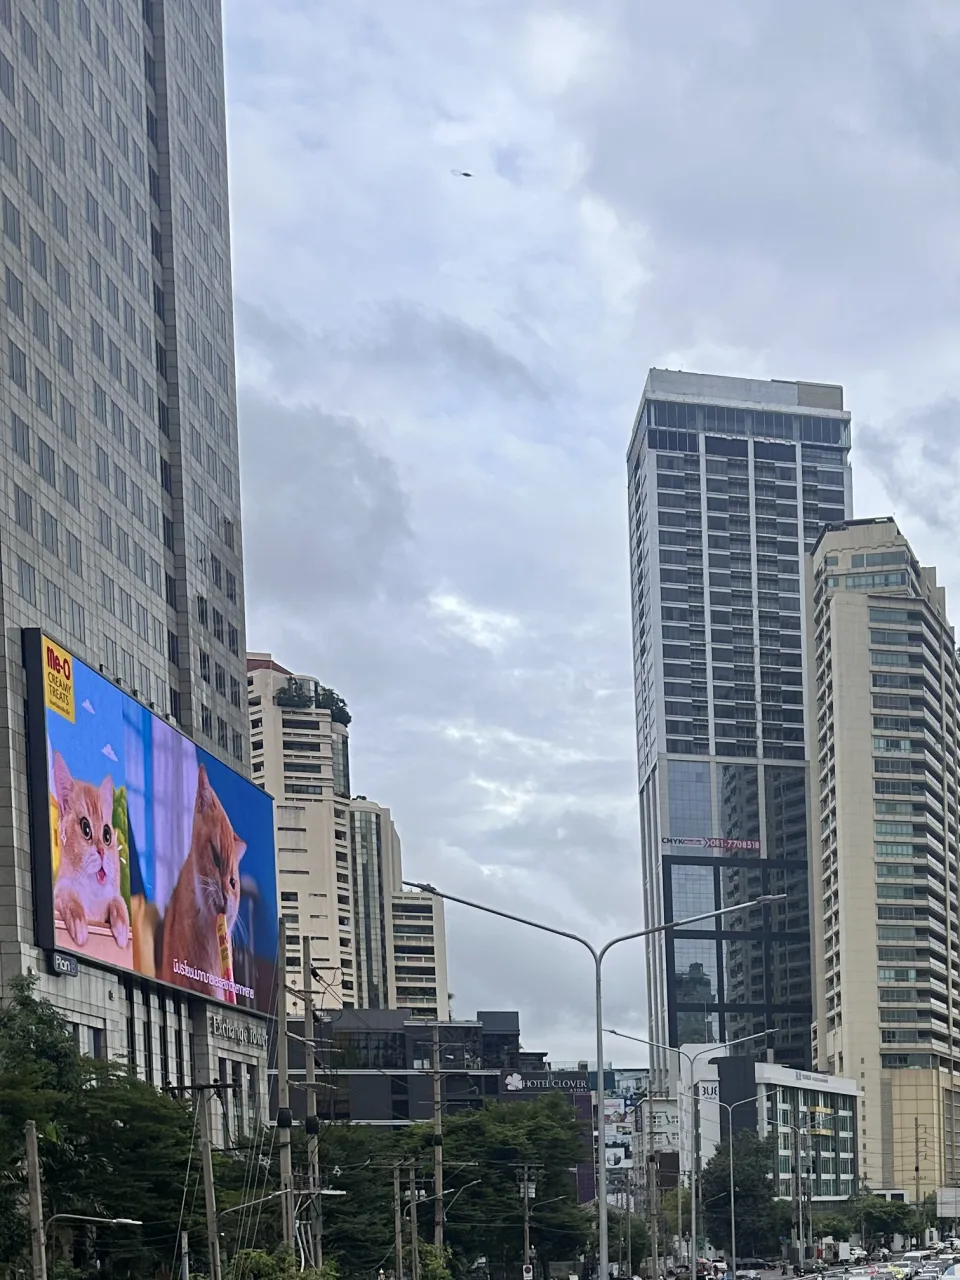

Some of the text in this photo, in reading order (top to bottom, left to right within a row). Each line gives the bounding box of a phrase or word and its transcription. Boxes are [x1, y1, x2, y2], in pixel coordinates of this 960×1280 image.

[47, 671, 72, 695] CREAMY
[48, 684, 70, 706] TREATS
[213, 1015, 268, 1048] Exchange Tower
[522, 1079, 587, 1088] HOTEL CLOVER
